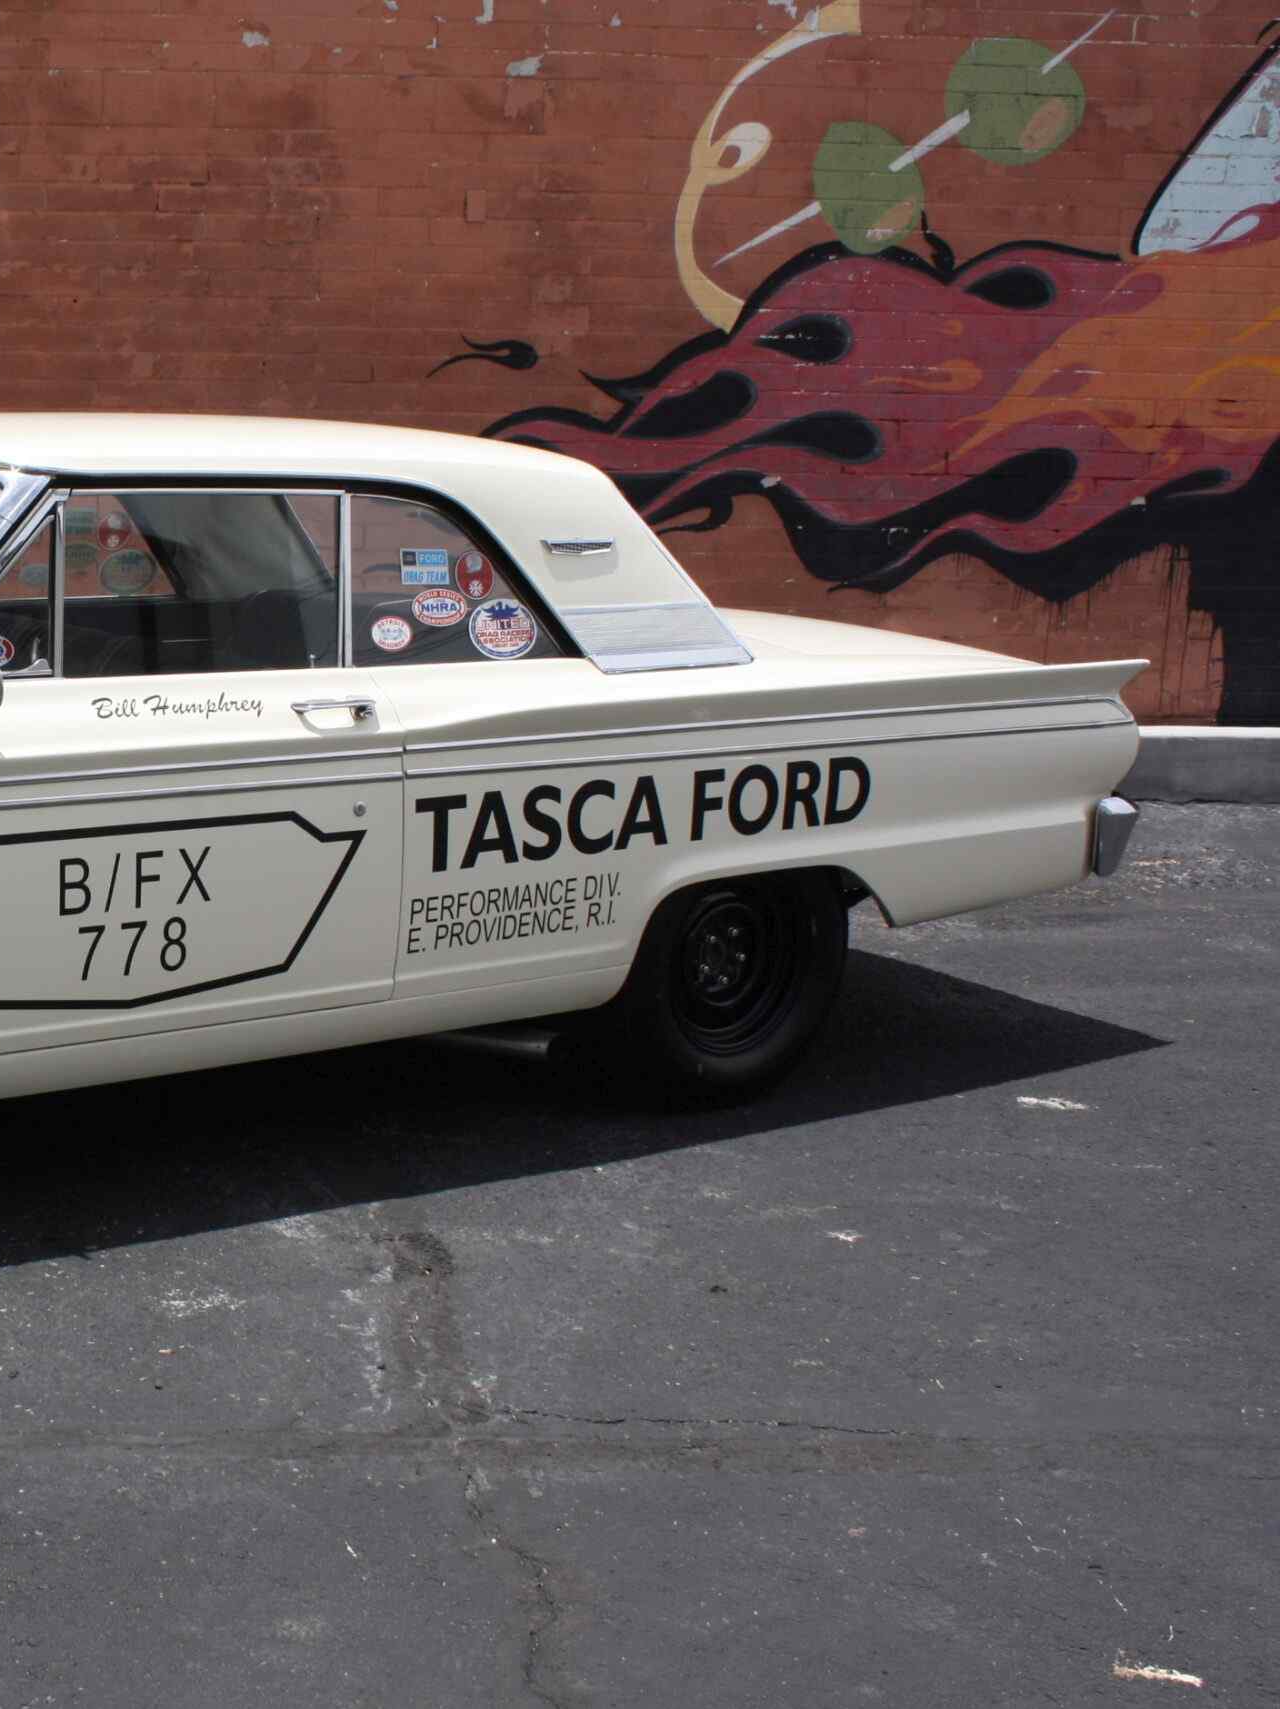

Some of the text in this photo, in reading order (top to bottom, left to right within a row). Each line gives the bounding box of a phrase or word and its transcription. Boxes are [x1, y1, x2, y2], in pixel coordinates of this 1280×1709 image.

[419, 552, 445, 561] FORD
[421, 603, 458, 613] NHRA
[92, 692, 264, 720] Bill Humphrey
[415, 756, 871, 873] TASCA FORD
[59, 846, 212, 916] B/FX
[410, 872, 622, 925] PERFORMANCE DIV.
[78, 916, 187, 981] 778
[406, 901, 616, 954] E. PROVIDENCE, R.I.
